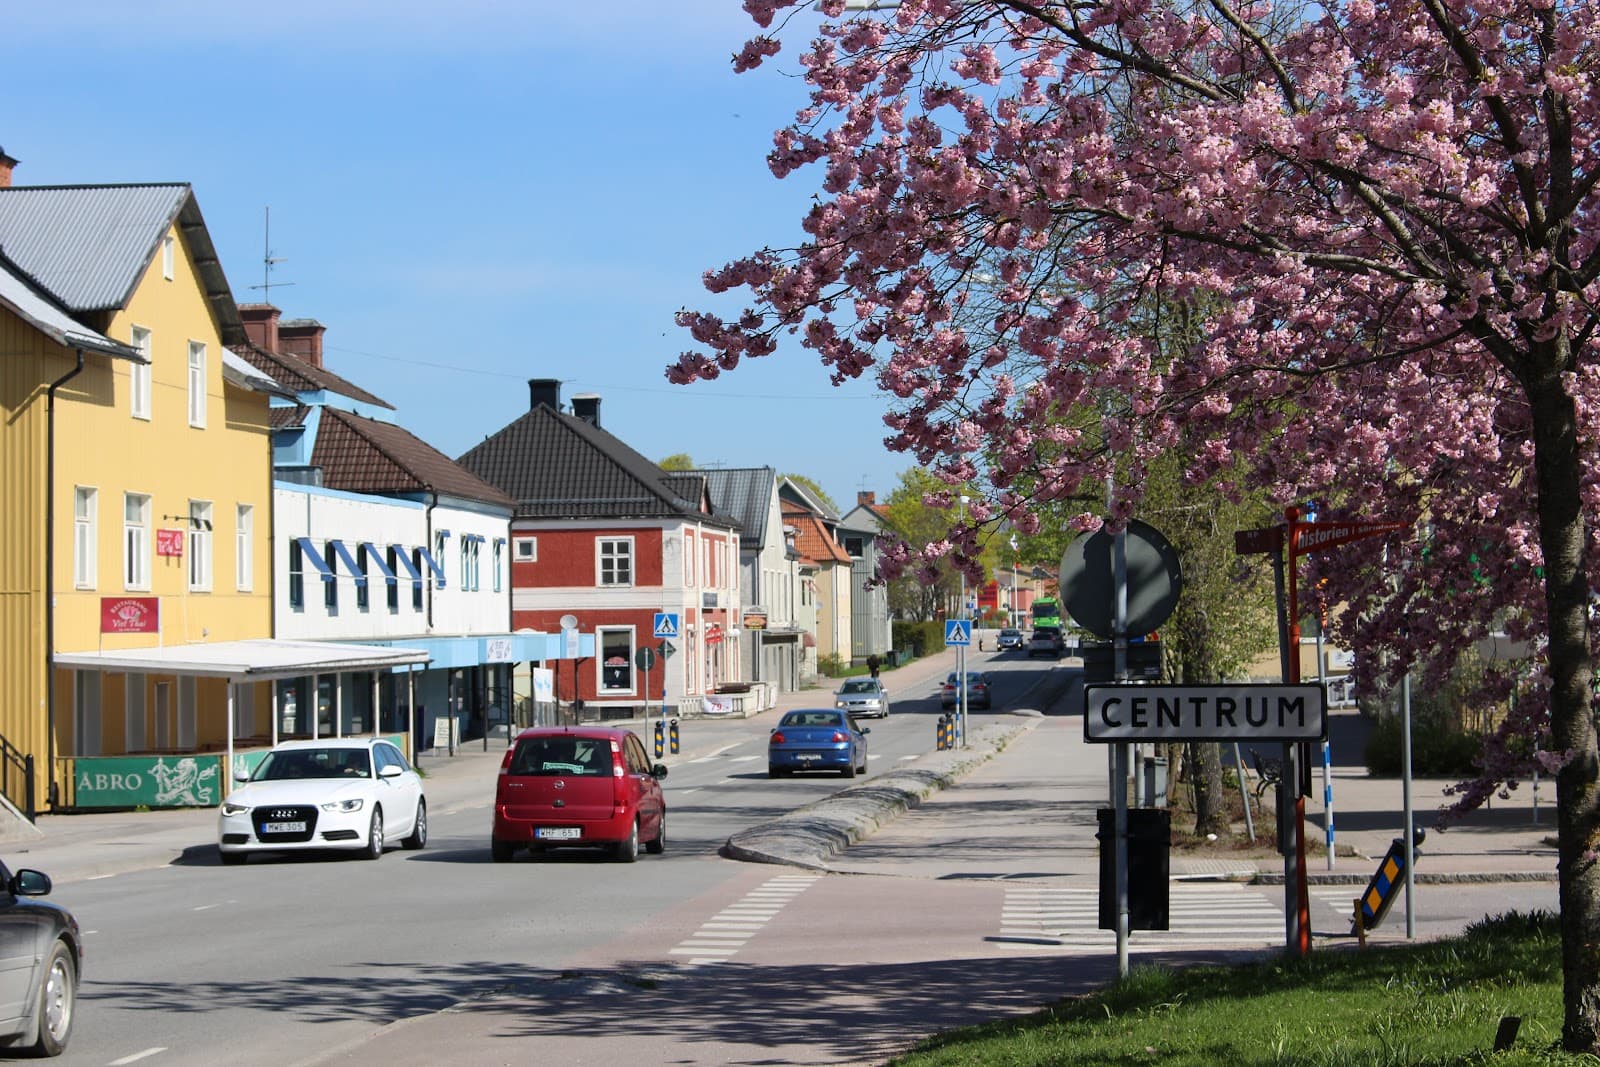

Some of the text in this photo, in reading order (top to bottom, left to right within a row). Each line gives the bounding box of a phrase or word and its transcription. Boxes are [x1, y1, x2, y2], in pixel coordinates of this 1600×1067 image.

[1298, 526, 1349, 549] historien
[1101, 696, 1305, 728] CENTRUM
[78, 772, 142, 790] ÅBRO
[562, 829, 578, 837] 651
